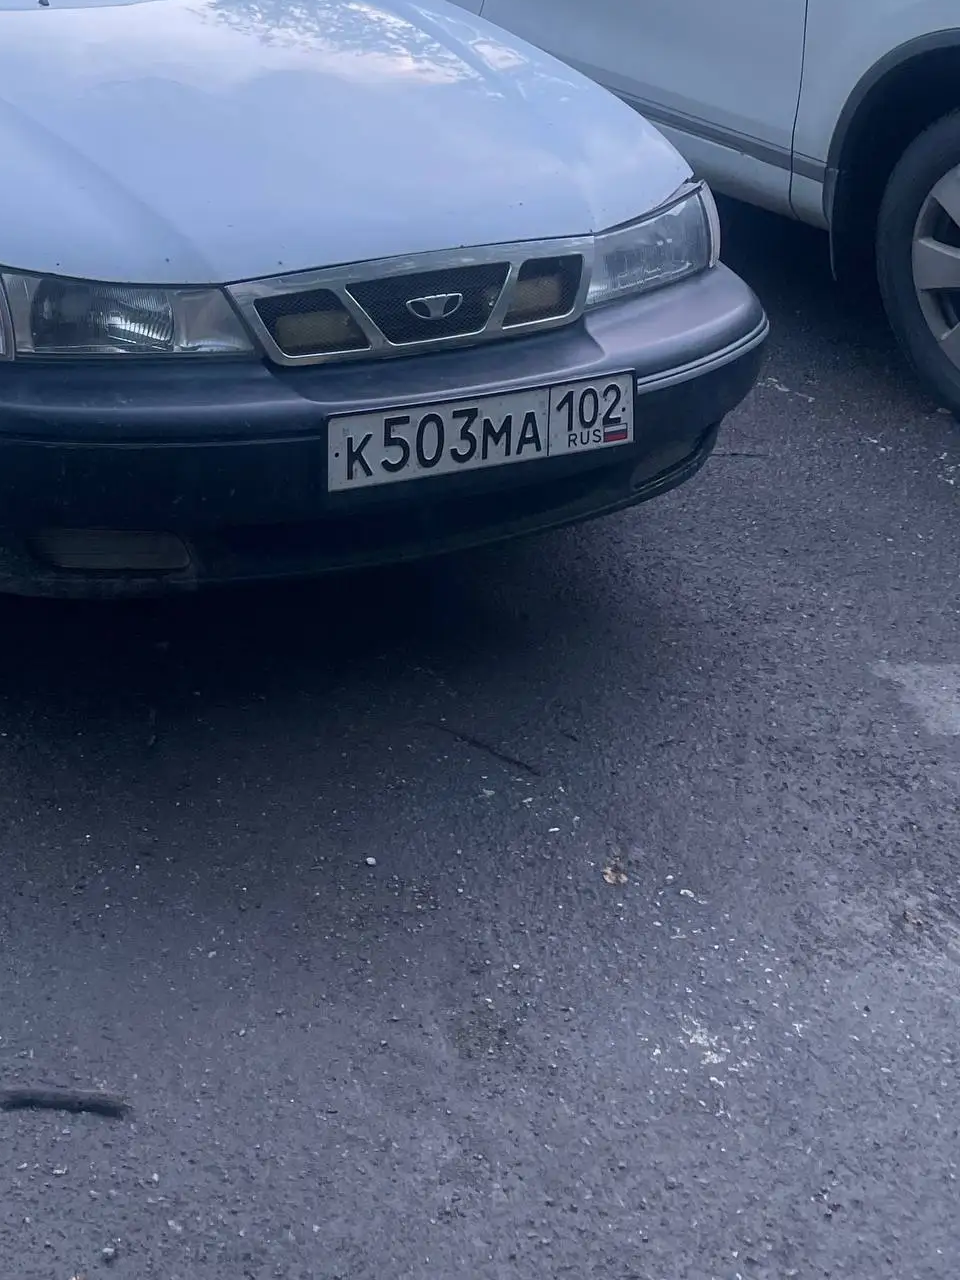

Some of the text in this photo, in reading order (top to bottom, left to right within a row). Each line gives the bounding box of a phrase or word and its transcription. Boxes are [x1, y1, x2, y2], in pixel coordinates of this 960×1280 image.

[346, 384, 621, 480] К503МА 102
[568, 429, 602, 448] RUS
